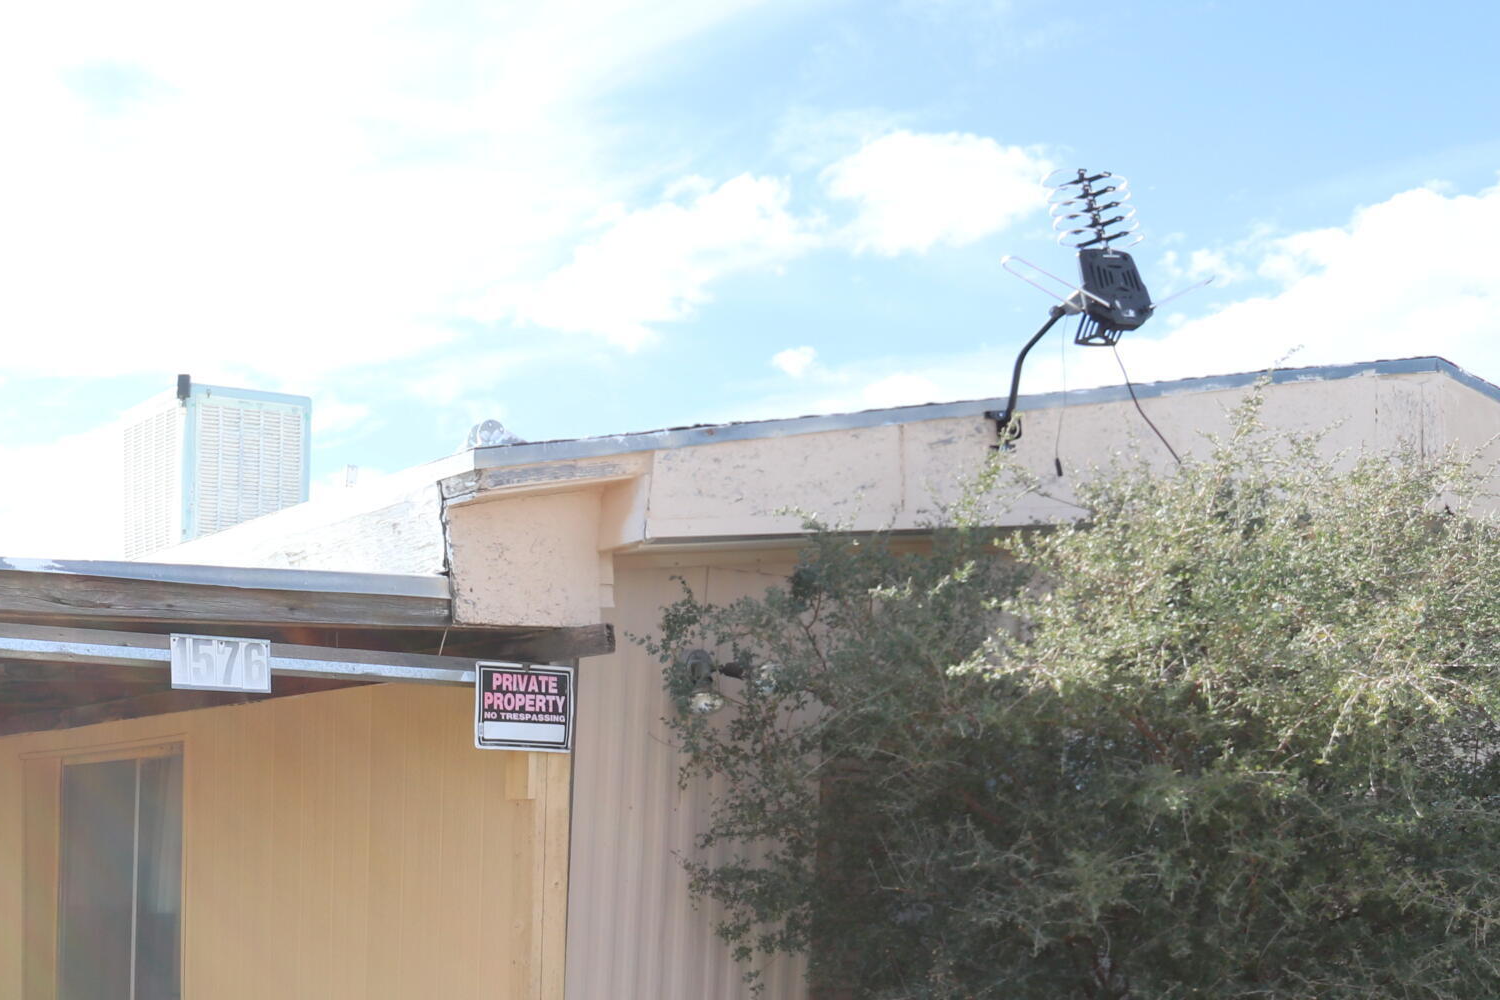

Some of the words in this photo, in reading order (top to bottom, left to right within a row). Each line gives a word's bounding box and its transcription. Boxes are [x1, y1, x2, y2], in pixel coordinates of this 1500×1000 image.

[176, 638, 266, 688] 1576
[492, 672, 558, 693] PRIVATE
[484, 692, 565, 713] PROPERTY
[484, 711, 498, 719] NO
[500, 712, 566, 722] TRESPASSING
